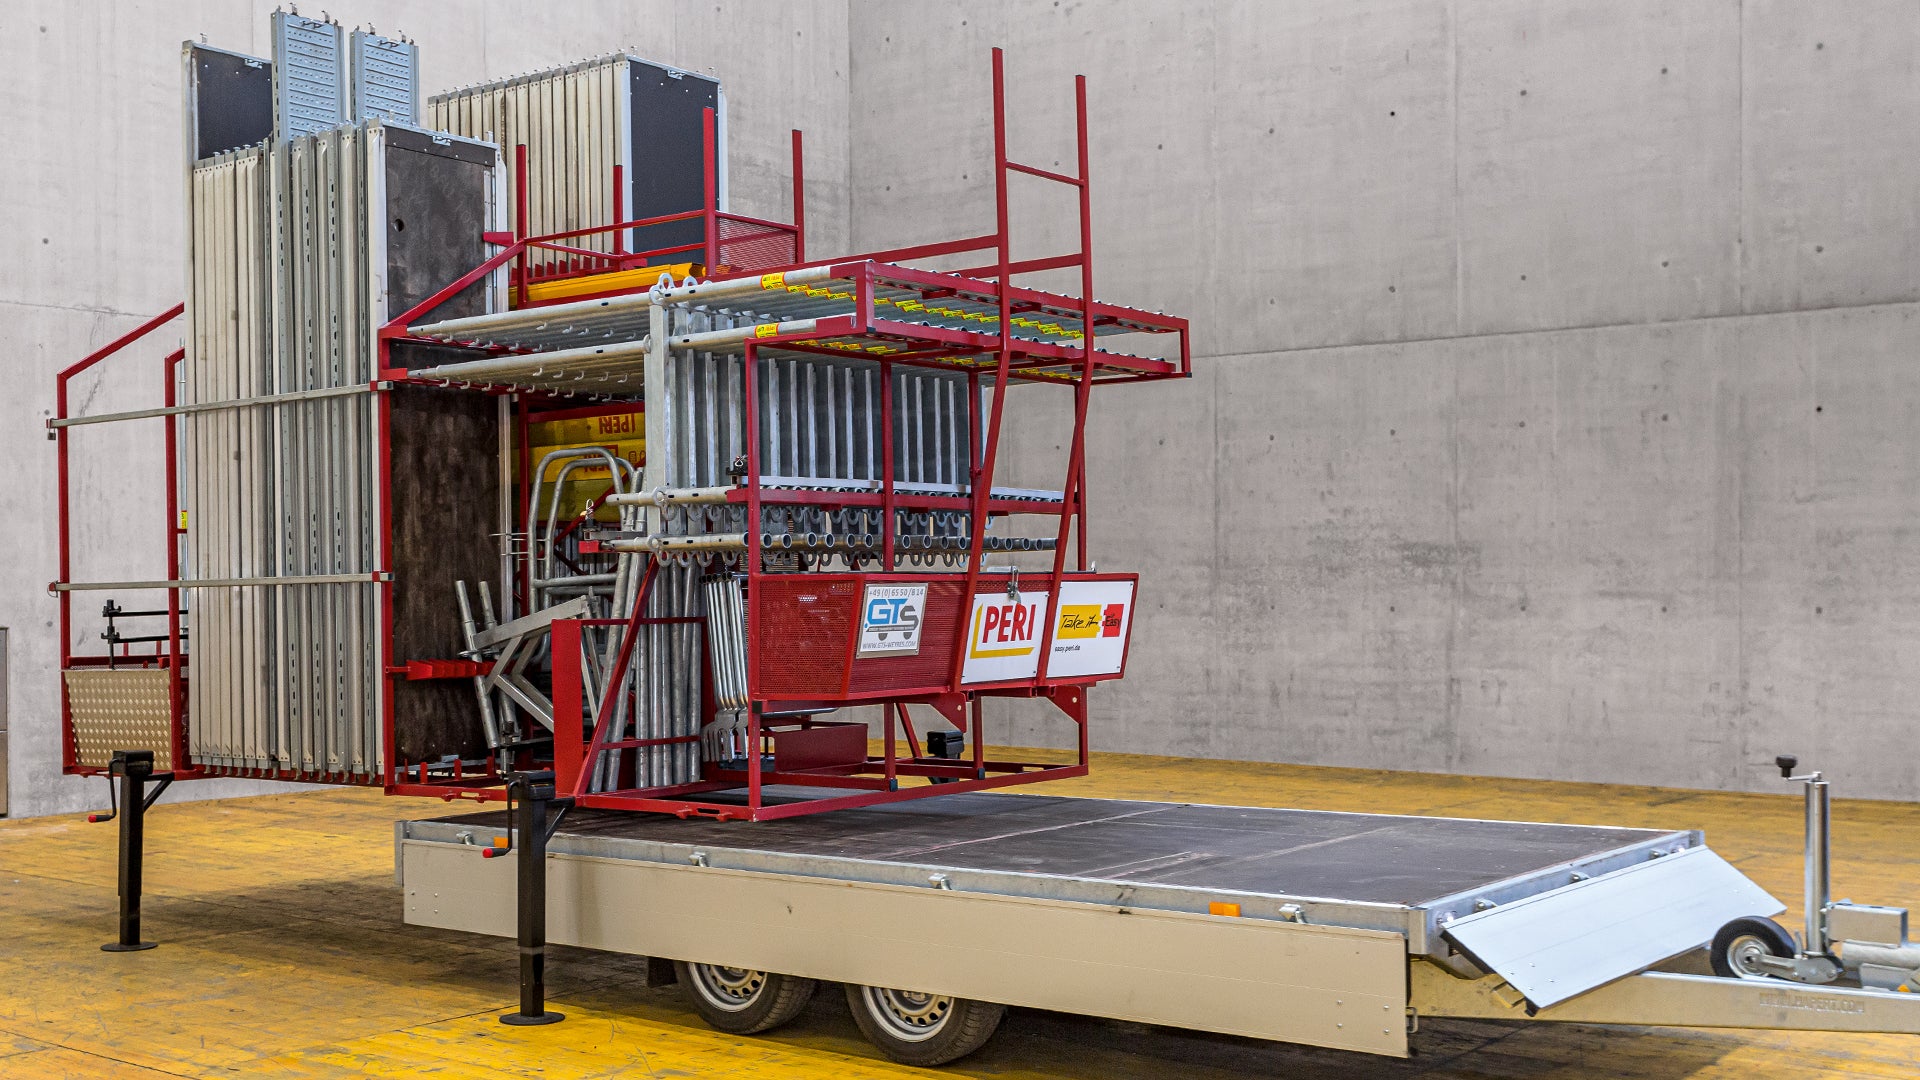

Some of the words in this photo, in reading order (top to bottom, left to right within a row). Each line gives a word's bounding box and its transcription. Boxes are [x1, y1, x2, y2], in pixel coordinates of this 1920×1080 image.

[867, 598, 919, 627] GTS
[982, 603, 1036, 643] PERI
[1061, 614, 1084, 630] Take
